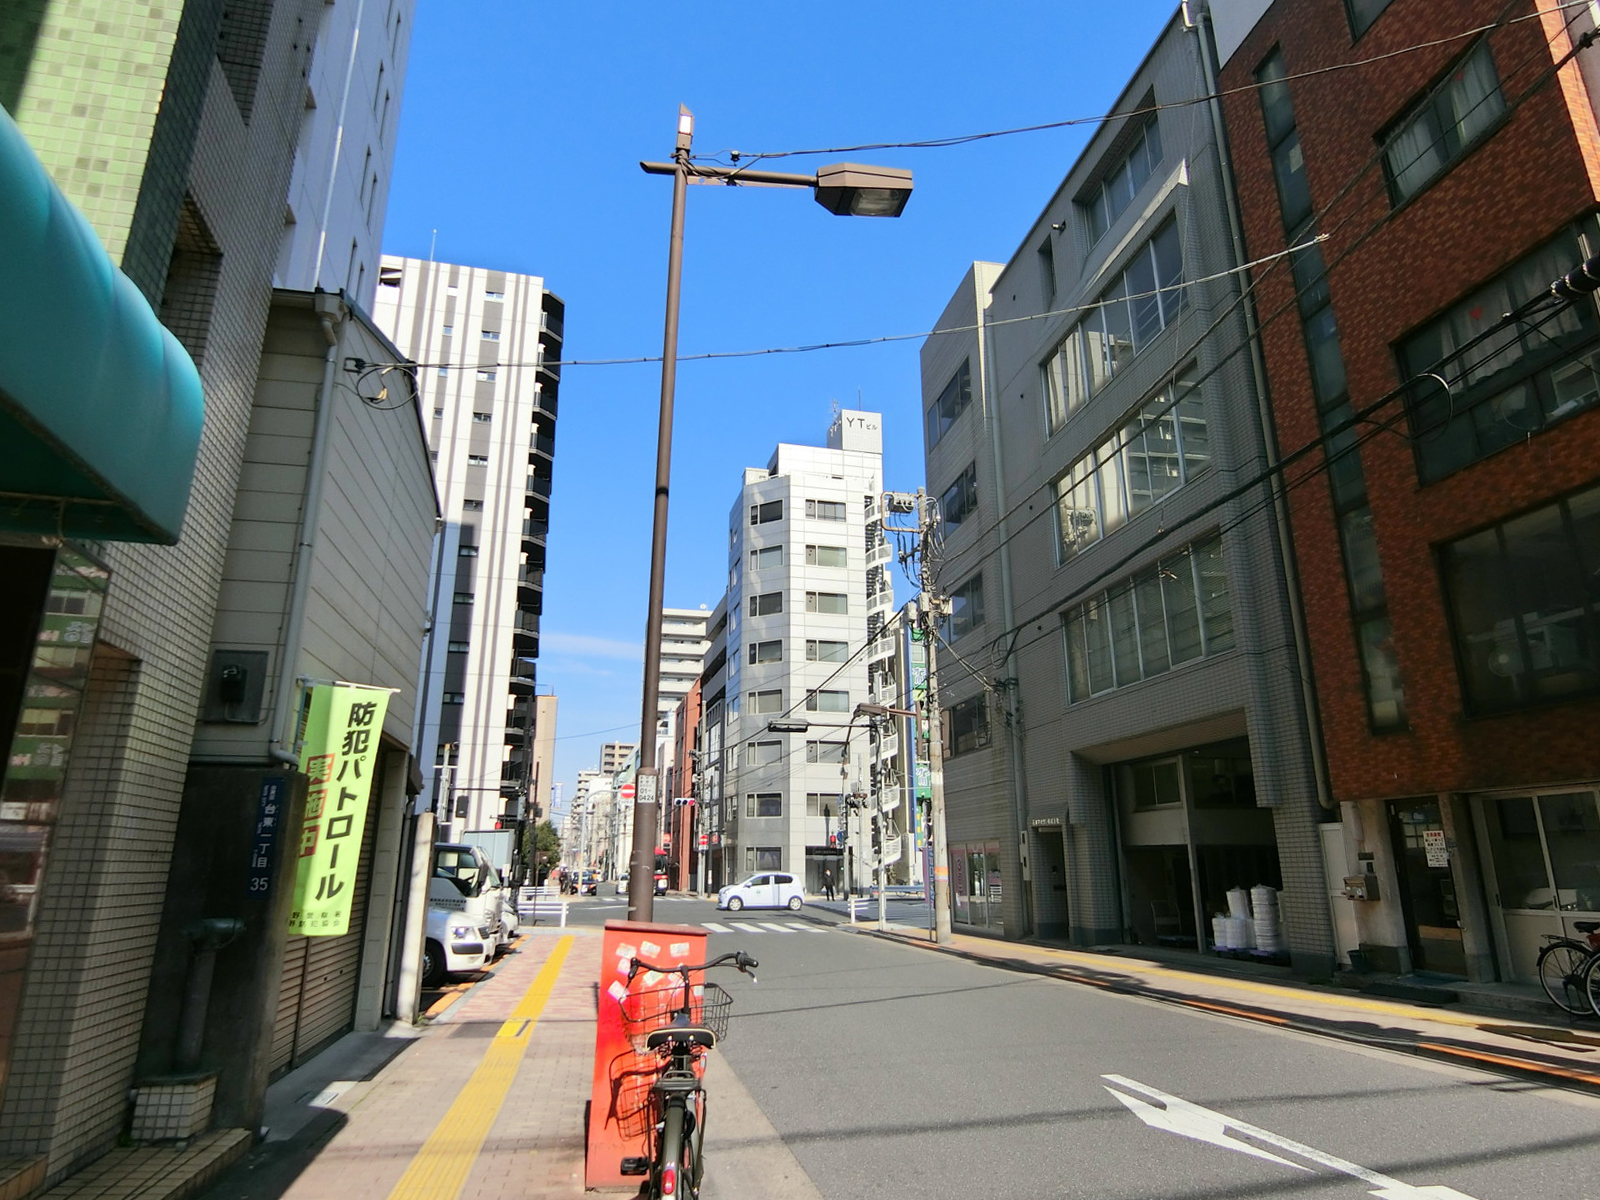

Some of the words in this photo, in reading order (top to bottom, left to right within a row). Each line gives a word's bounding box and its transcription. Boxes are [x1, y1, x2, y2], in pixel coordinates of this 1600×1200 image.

[257, 803, 276, 868] 台東一丁目
[301, 757, 333, 856] 実施中
[315, 701, 377, 901] 防犯パトロール
[250, 877, 269, 891] 35
